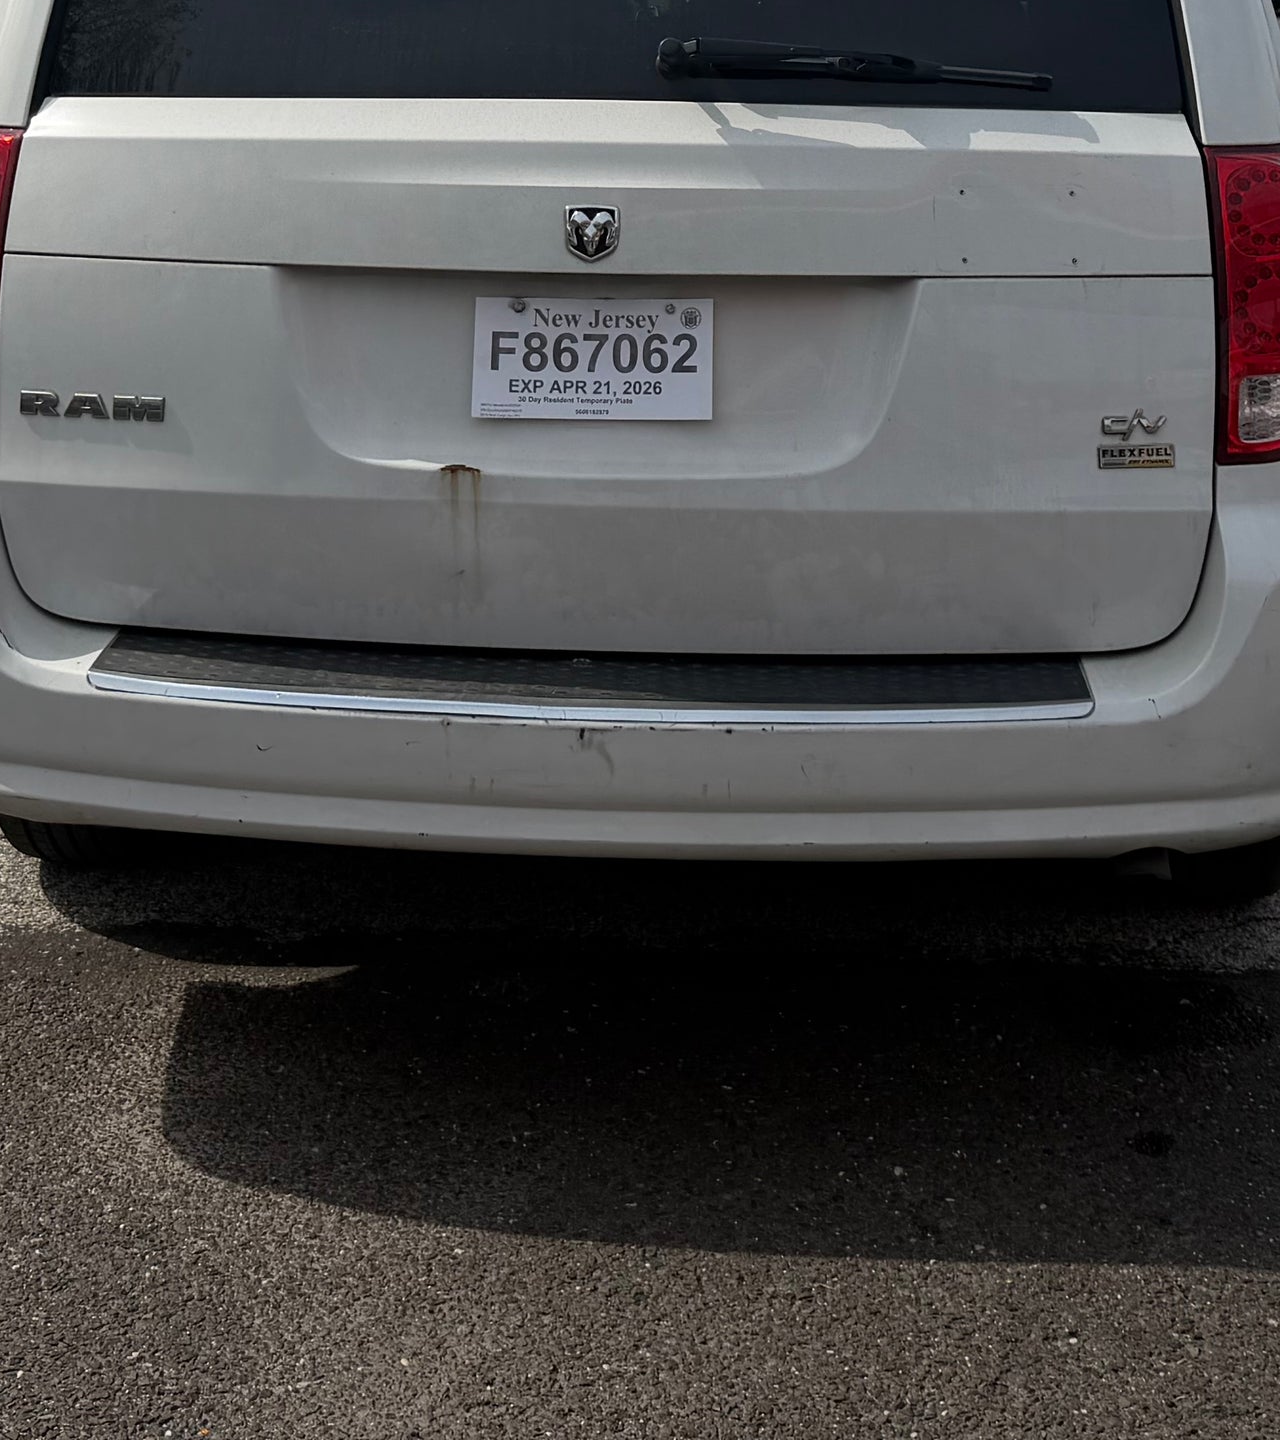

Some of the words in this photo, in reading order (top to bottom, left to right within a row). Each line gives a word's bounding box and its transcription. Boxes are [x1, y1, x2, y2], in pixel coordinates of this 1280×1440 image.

[533, 308, 582, 327] New
[588, 309, 659, 333] Jersey
[490, 331, 698, 373] F867062
[509, 379, 544, 394] EXP
[549, 380, 587, 394] APR
[593, 380, 617, 397] 21,
[623, 381, 663, 395] 2026
[20, 389, 166, 422] RAM
[576, 397, 614, 405] Temporary
